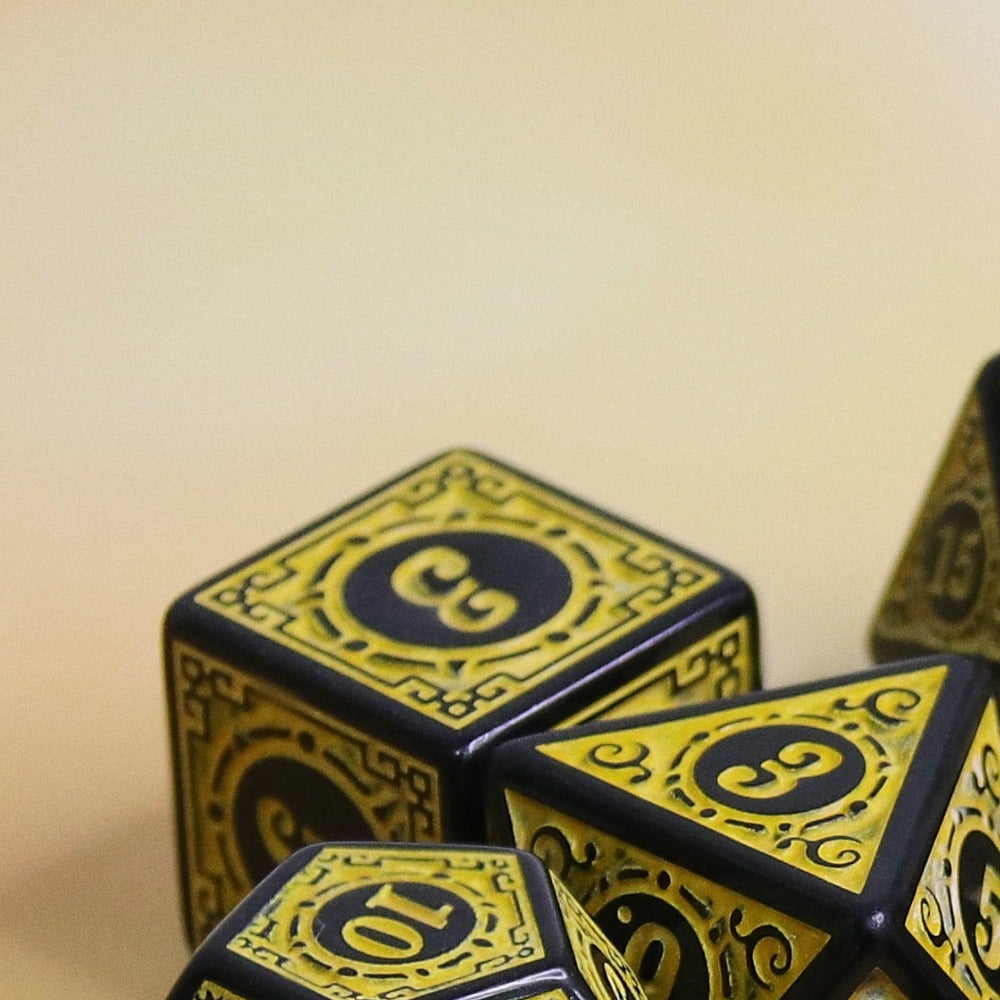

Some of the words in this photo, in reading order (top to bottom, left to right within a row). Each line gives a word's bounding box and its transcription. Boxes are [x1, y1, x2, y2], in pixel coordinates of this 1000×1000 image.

[391, 546, 519, 632] 3
[717, 740, 842, 799] 3
[341, 885, 452, 961] 10
